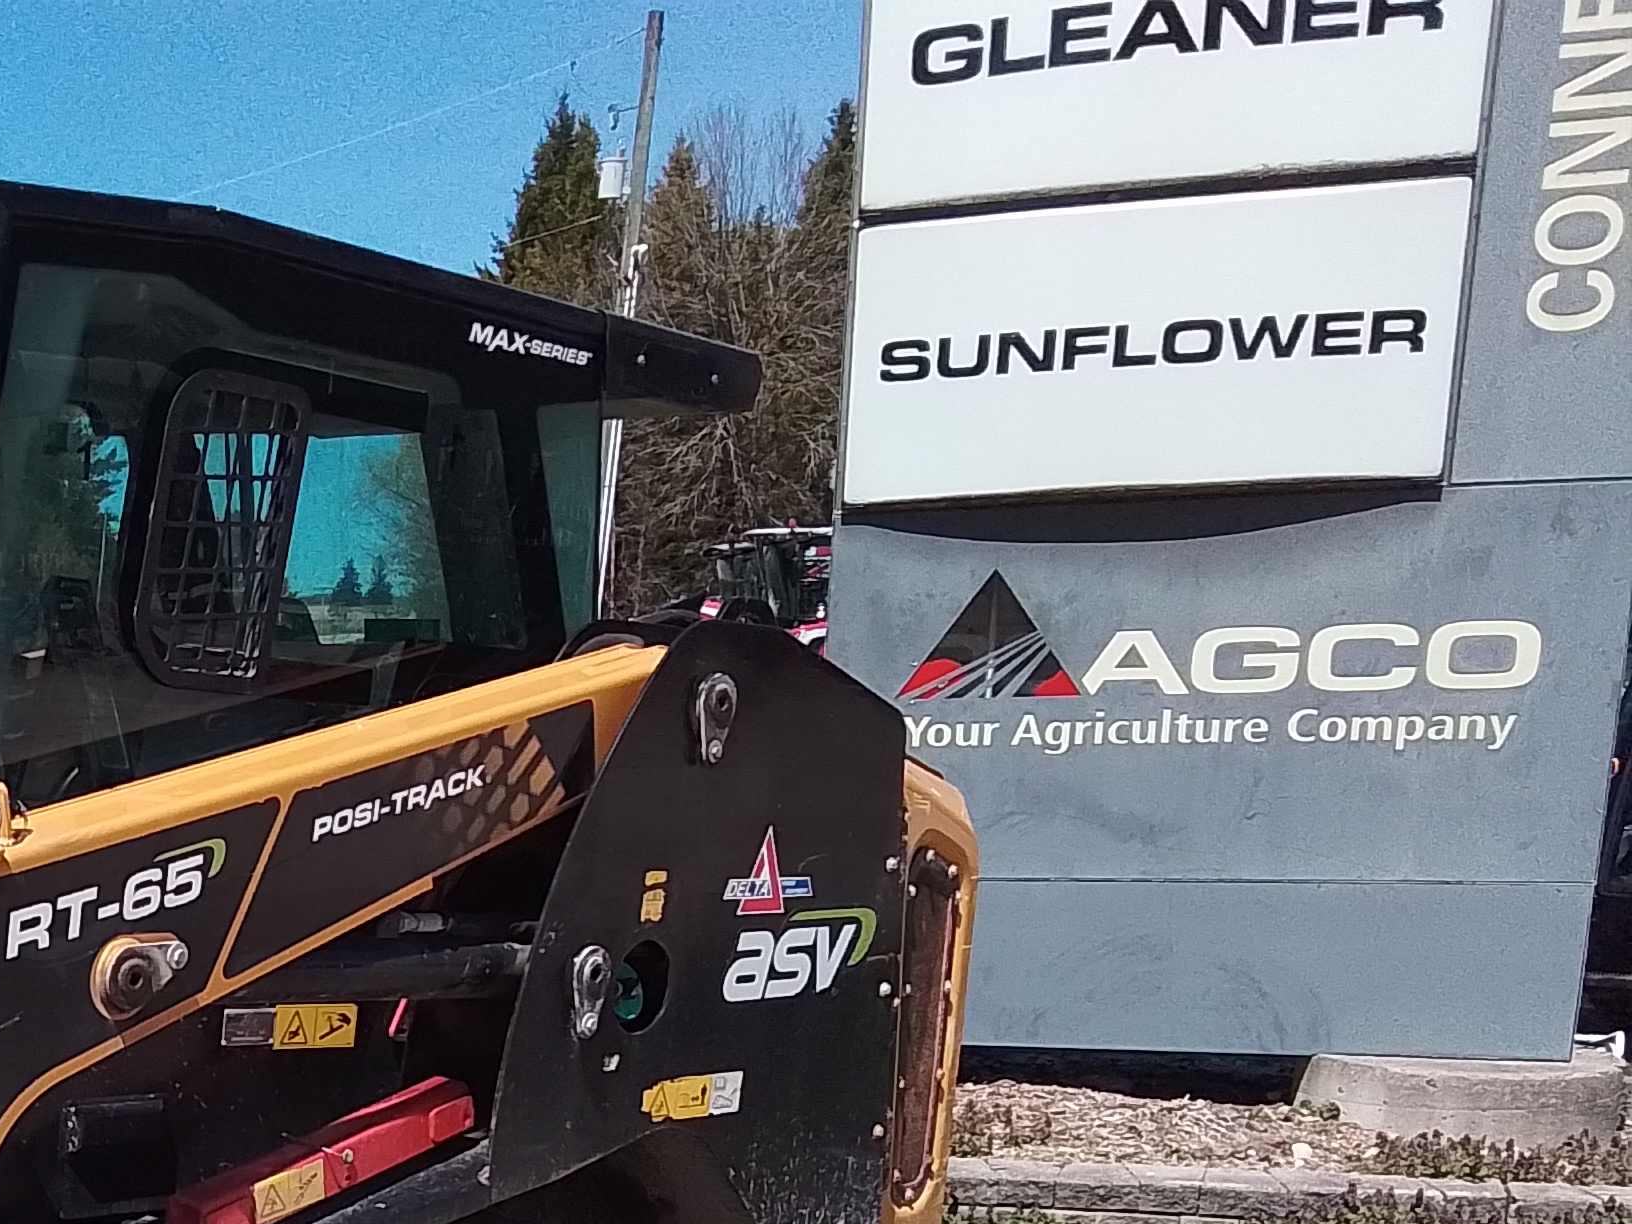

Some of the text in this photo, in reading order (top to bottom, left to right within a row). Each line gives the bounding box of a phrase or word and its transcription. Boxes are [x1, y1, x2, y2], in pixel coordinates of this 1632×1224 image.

[911, 0, 1443, 87] GLEANER
[468, 321, 589, 366] MAX-SERIES
[879, 309, 1428, 384] SUNFLOWER
[1082, 620, 1542, 695] AGCO
[904, 708, 1518, 754] Your Agriculture Company
[312, 764, 486, 842] POSI-TRACK
[5, 853, 205, 959] RT-65
[727, 881, 770, 897] DELTA
